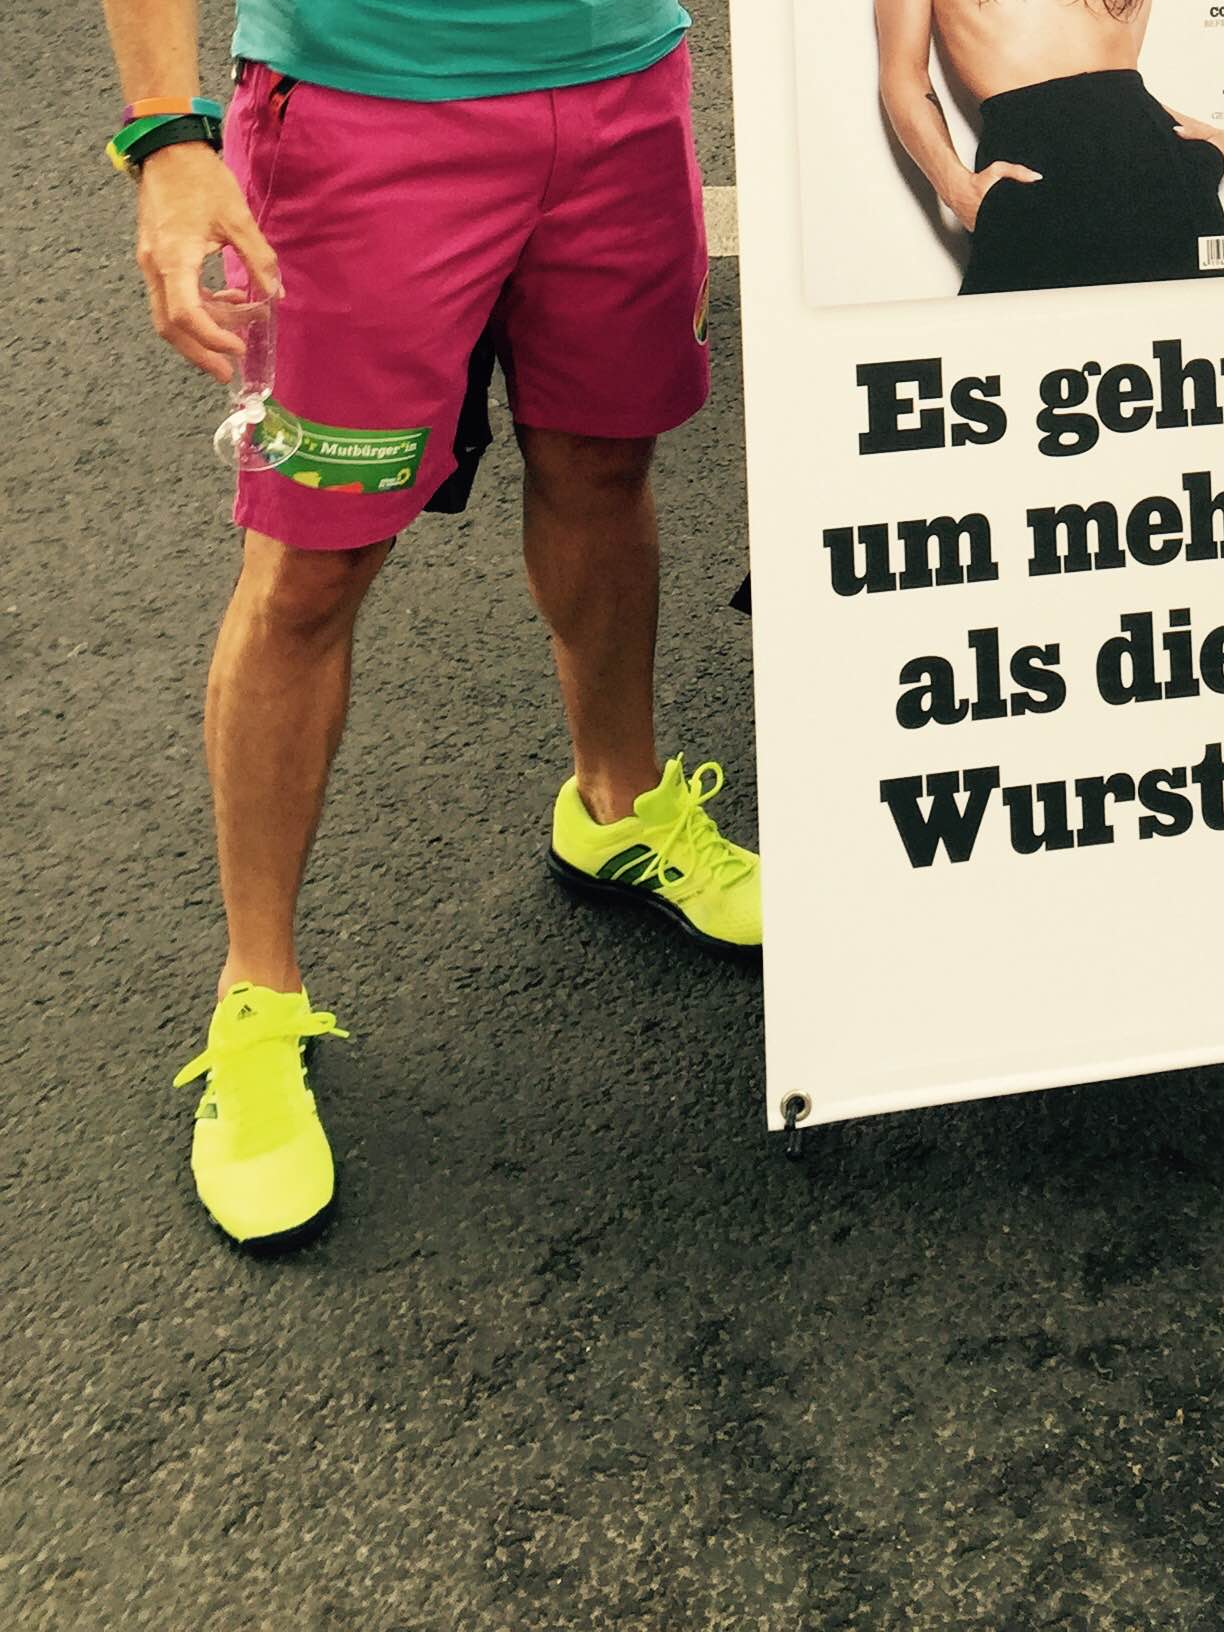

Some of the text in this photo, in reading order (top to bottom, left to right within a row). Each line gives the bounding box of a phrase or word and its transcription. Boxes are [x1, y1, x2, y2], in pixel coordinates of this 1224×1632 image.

[856, 357, 1007, 456] Es
[823, 509, 999, 597] um
[895, 627, 1067, 730] als
